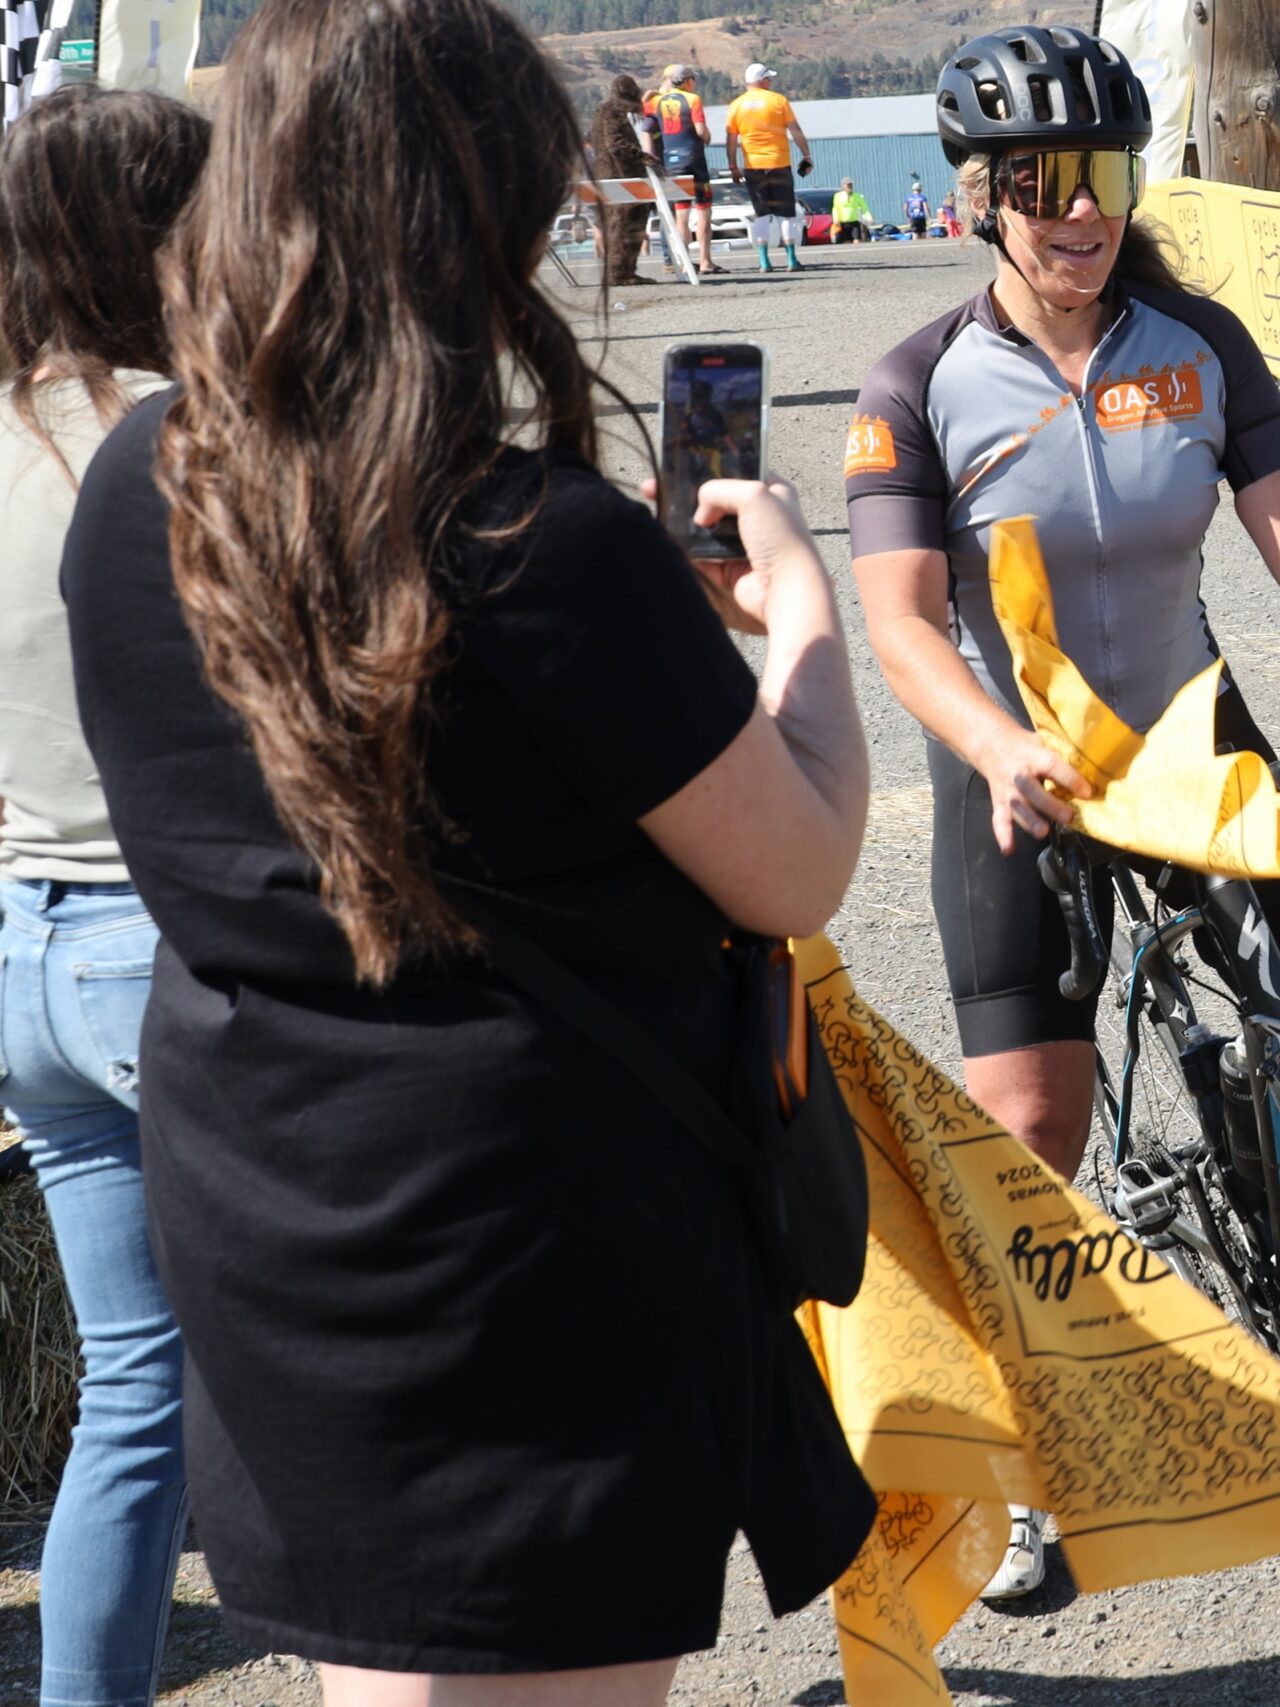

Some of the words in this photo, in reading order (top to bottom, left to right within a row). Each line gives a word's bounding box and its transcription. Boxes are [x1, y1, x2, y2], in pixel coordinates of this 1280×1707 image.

[1178, 206, 1199, 226] cycle
[1252, 216, 1278, 240] cycle
[1103, 381, 1160, 413] OAS
[1079, 870, 1098, 939] ULTEGRA
[997, 1163, 1043, 1186] 2024
[1006, 1224, 1174, 1302] Rally
